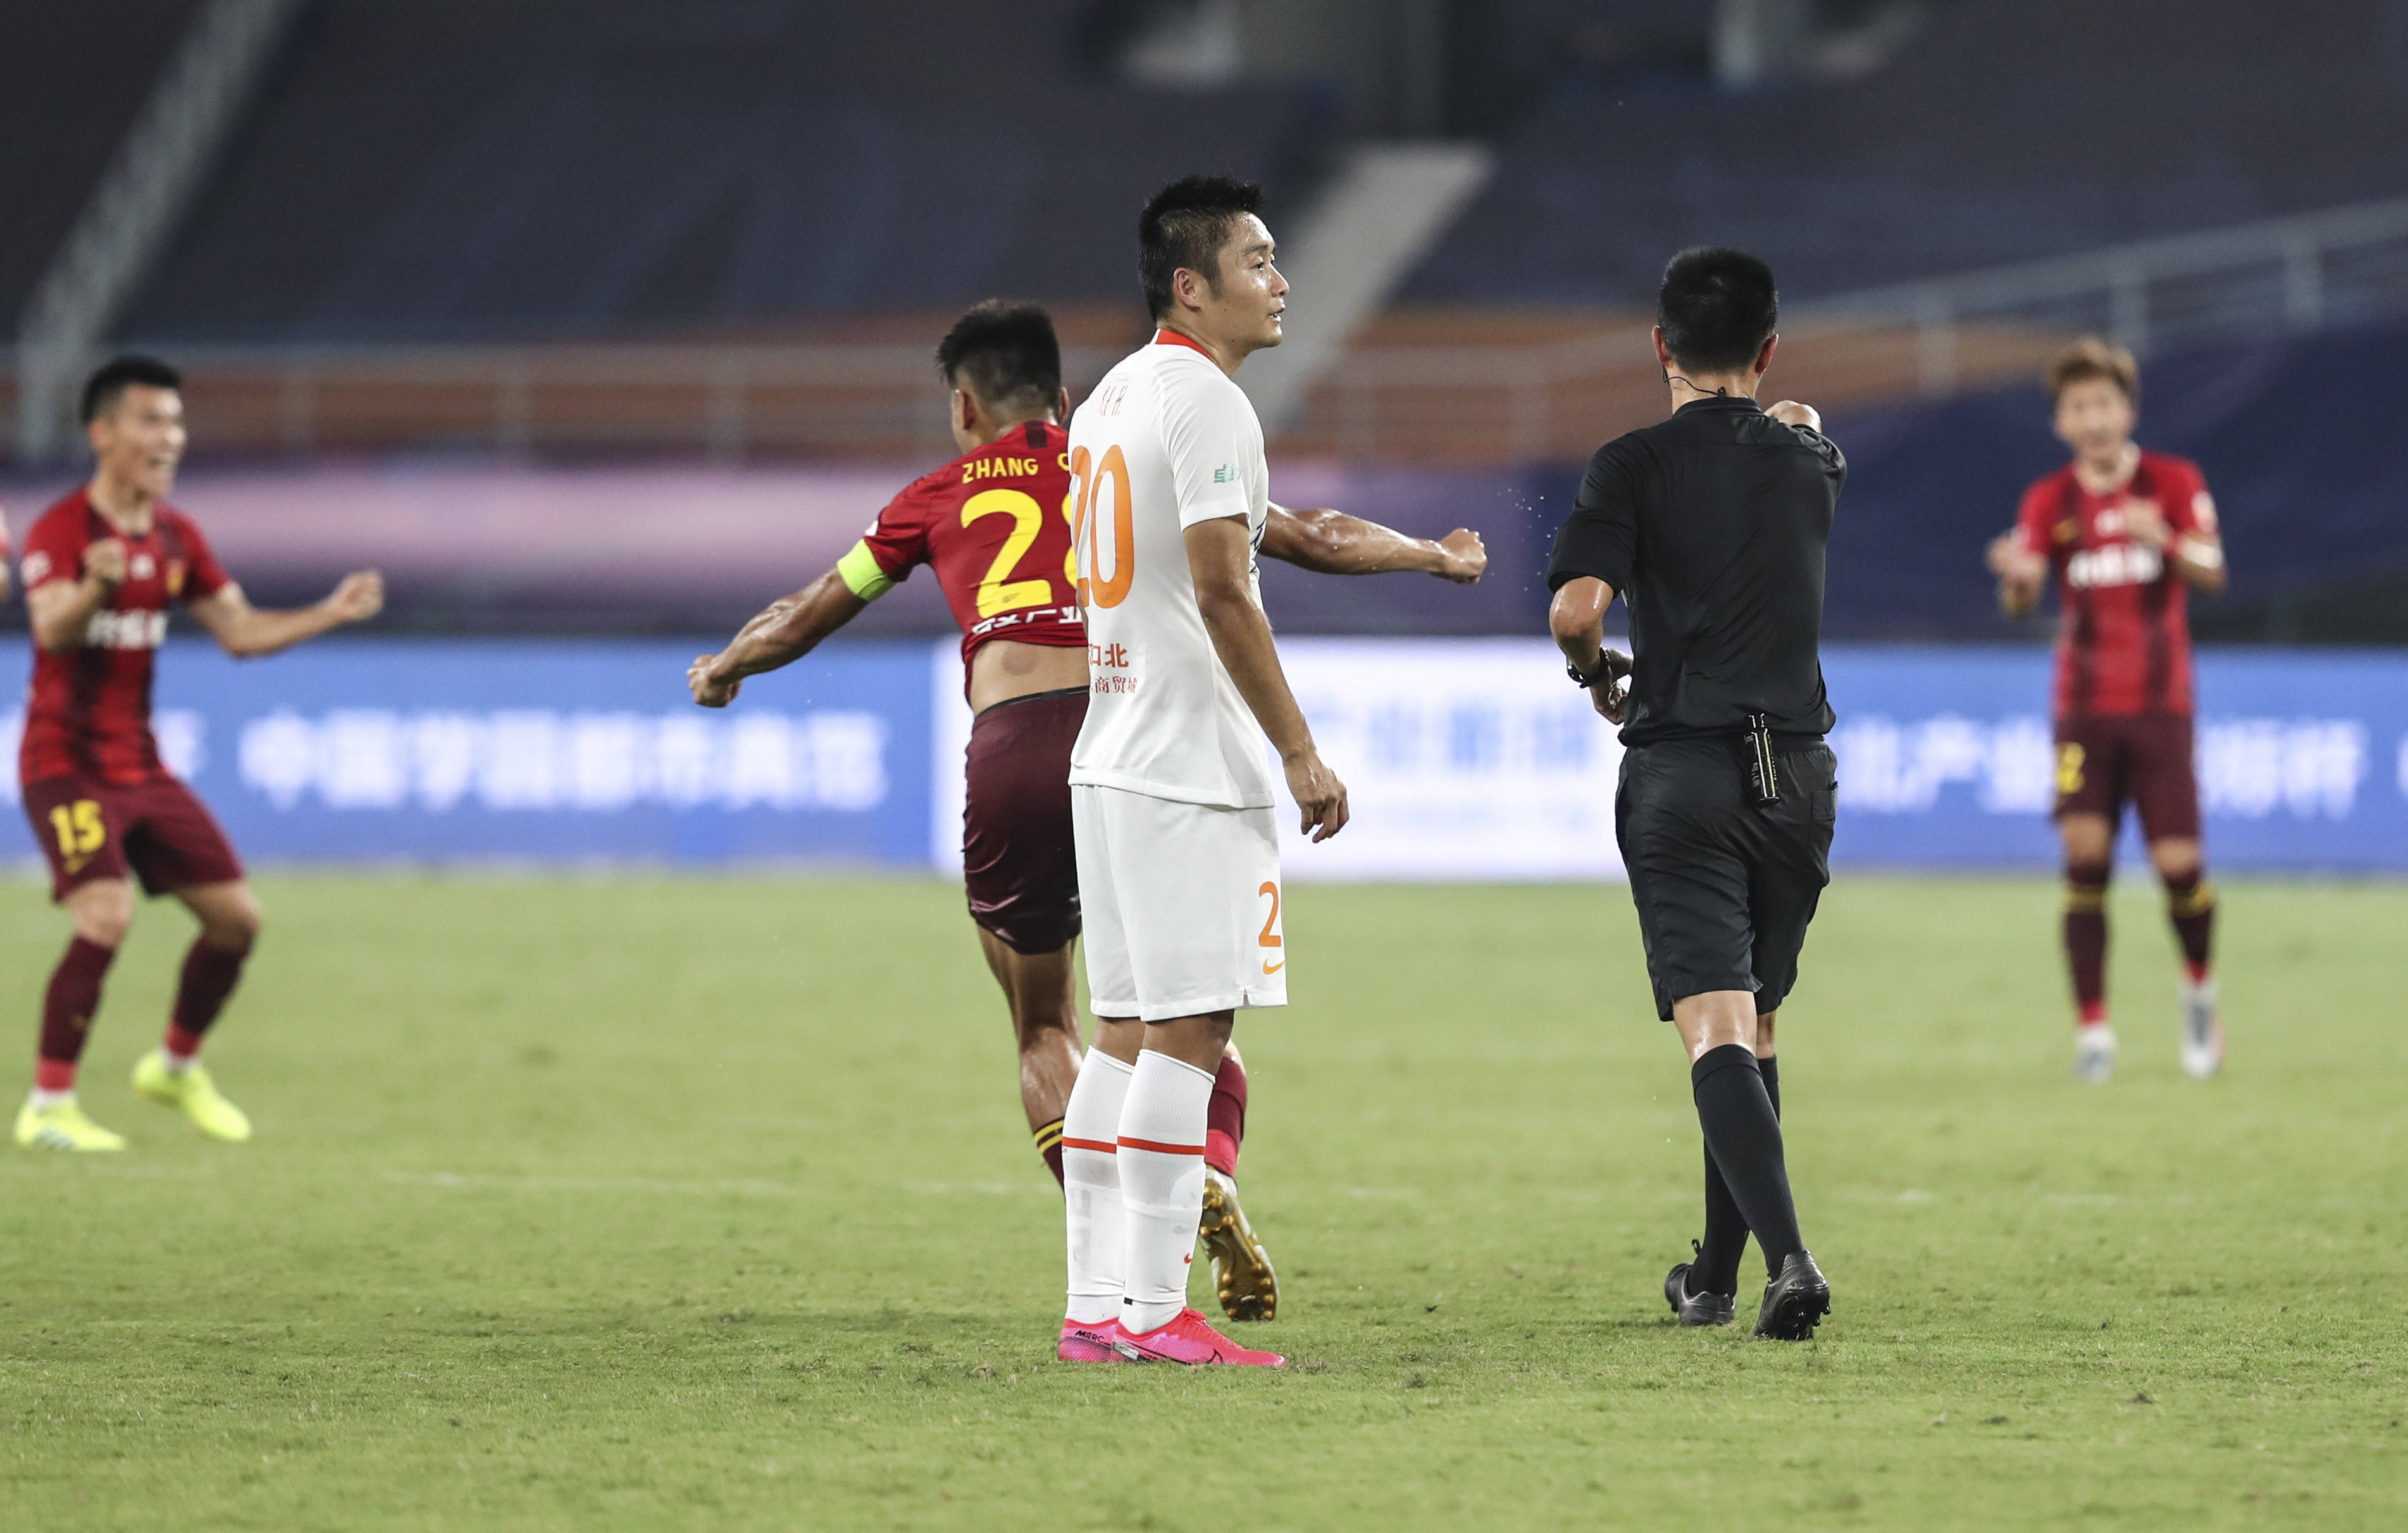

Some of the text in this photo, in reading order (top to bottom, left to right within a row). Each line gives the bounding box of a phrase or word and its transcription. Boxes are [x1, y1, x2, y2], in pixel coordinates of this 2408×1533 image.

[962, 457, 1039, 485] ZHANG
[1071, 444, 1134, 609] 20
[50, 799, 106, 857] 15
